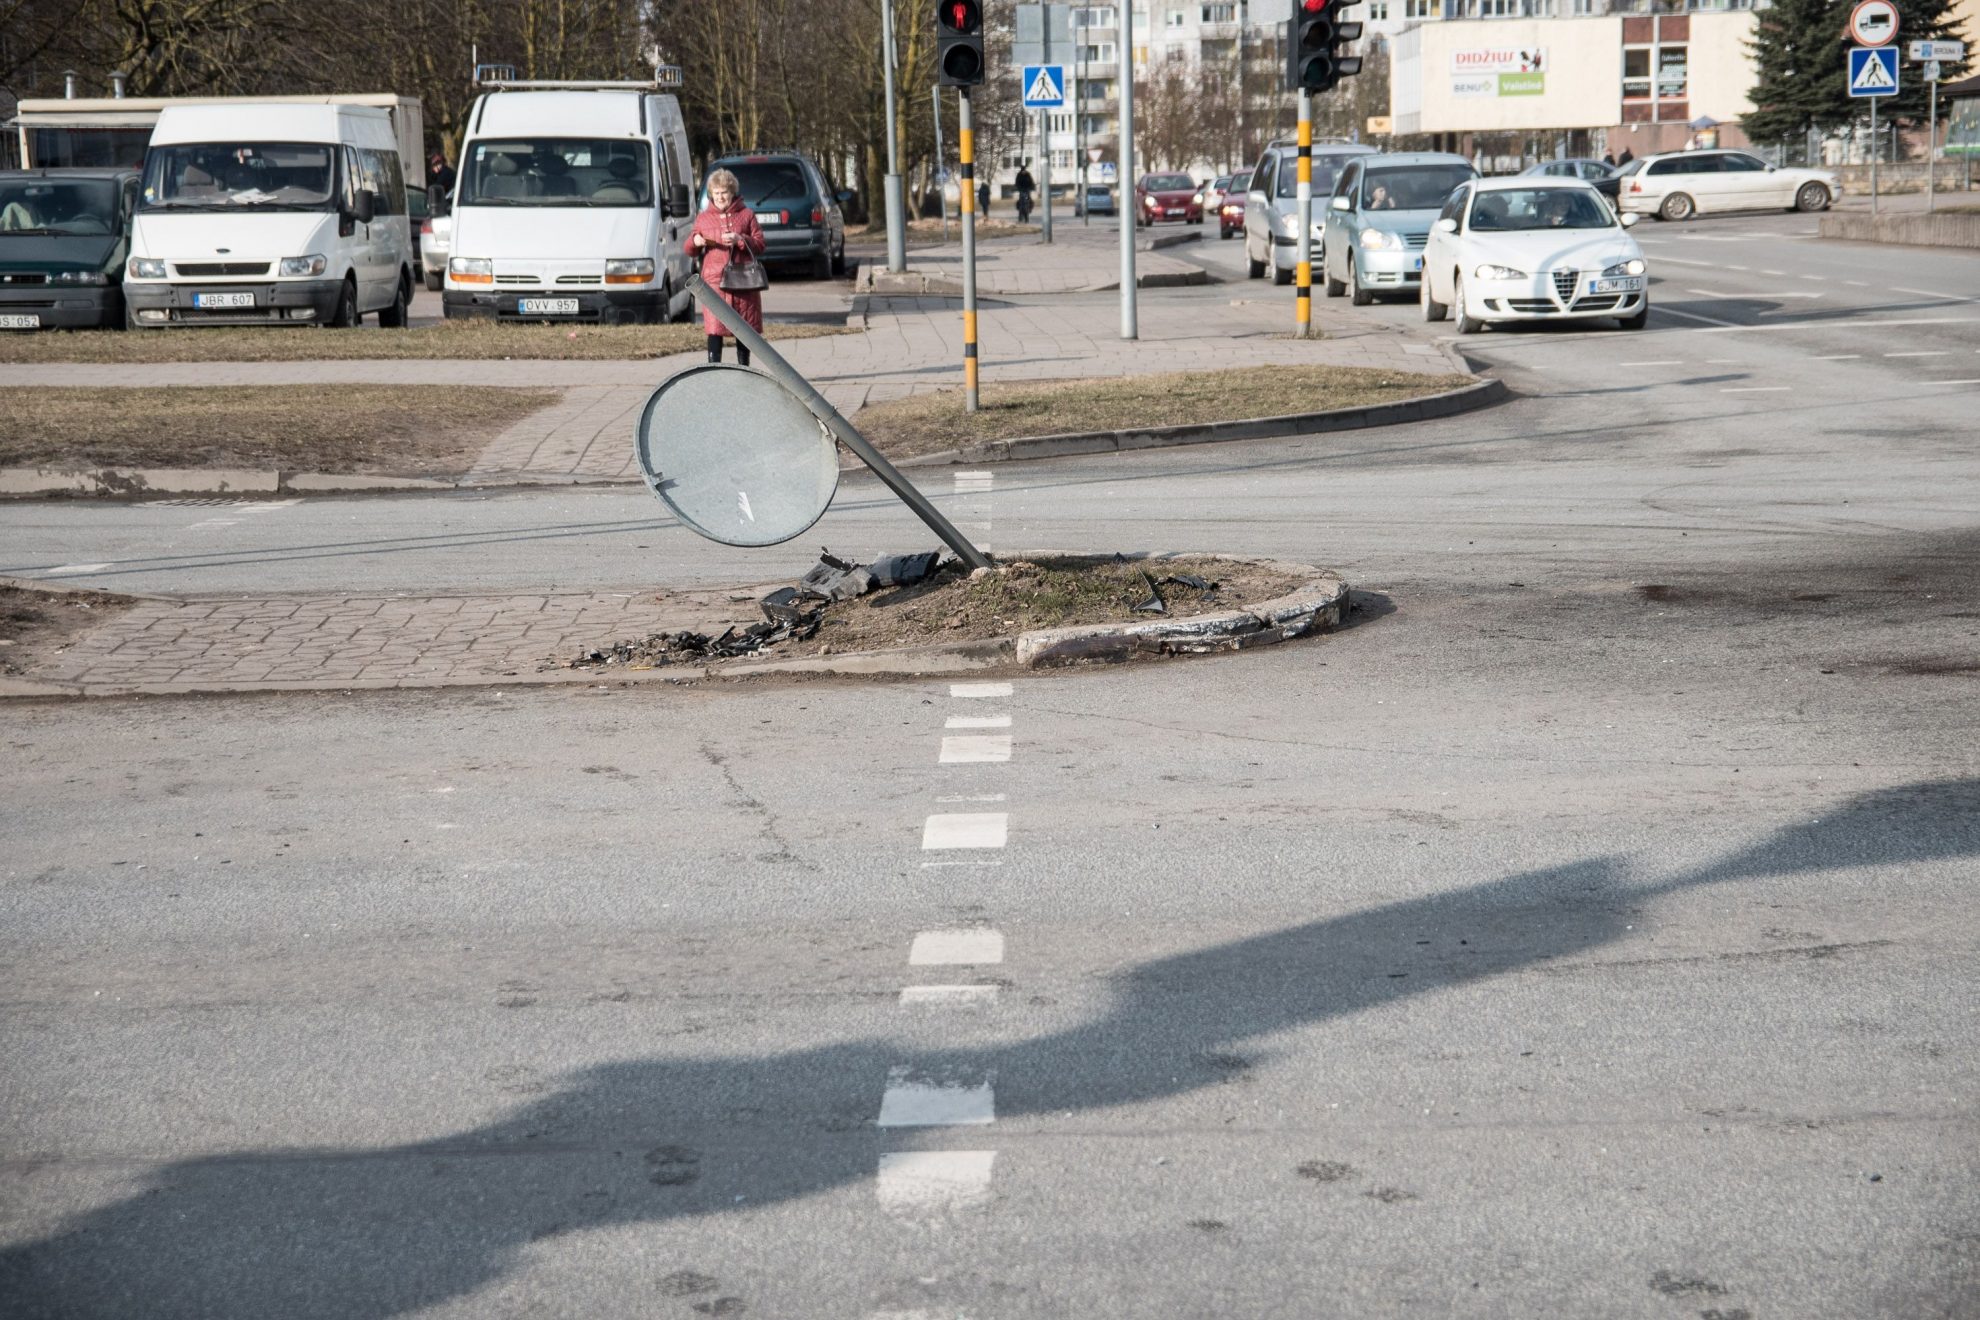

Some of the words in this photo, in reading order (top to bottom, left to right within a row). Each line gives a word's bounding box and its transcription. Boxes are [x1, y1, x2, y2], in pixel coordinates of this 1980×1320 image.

[1453, 83, 1481, 93] BENU
[1597, 280, 1618, 291] GJM
[1625, 279, 1640, 290] 161
[201, 295, 224, 306] JBR
[231, 294, 252, 305] 607
[526, 300, 549, 311] OVV
[556, 300, 577, 310] 957
[16, 316, 38, 327] 052
